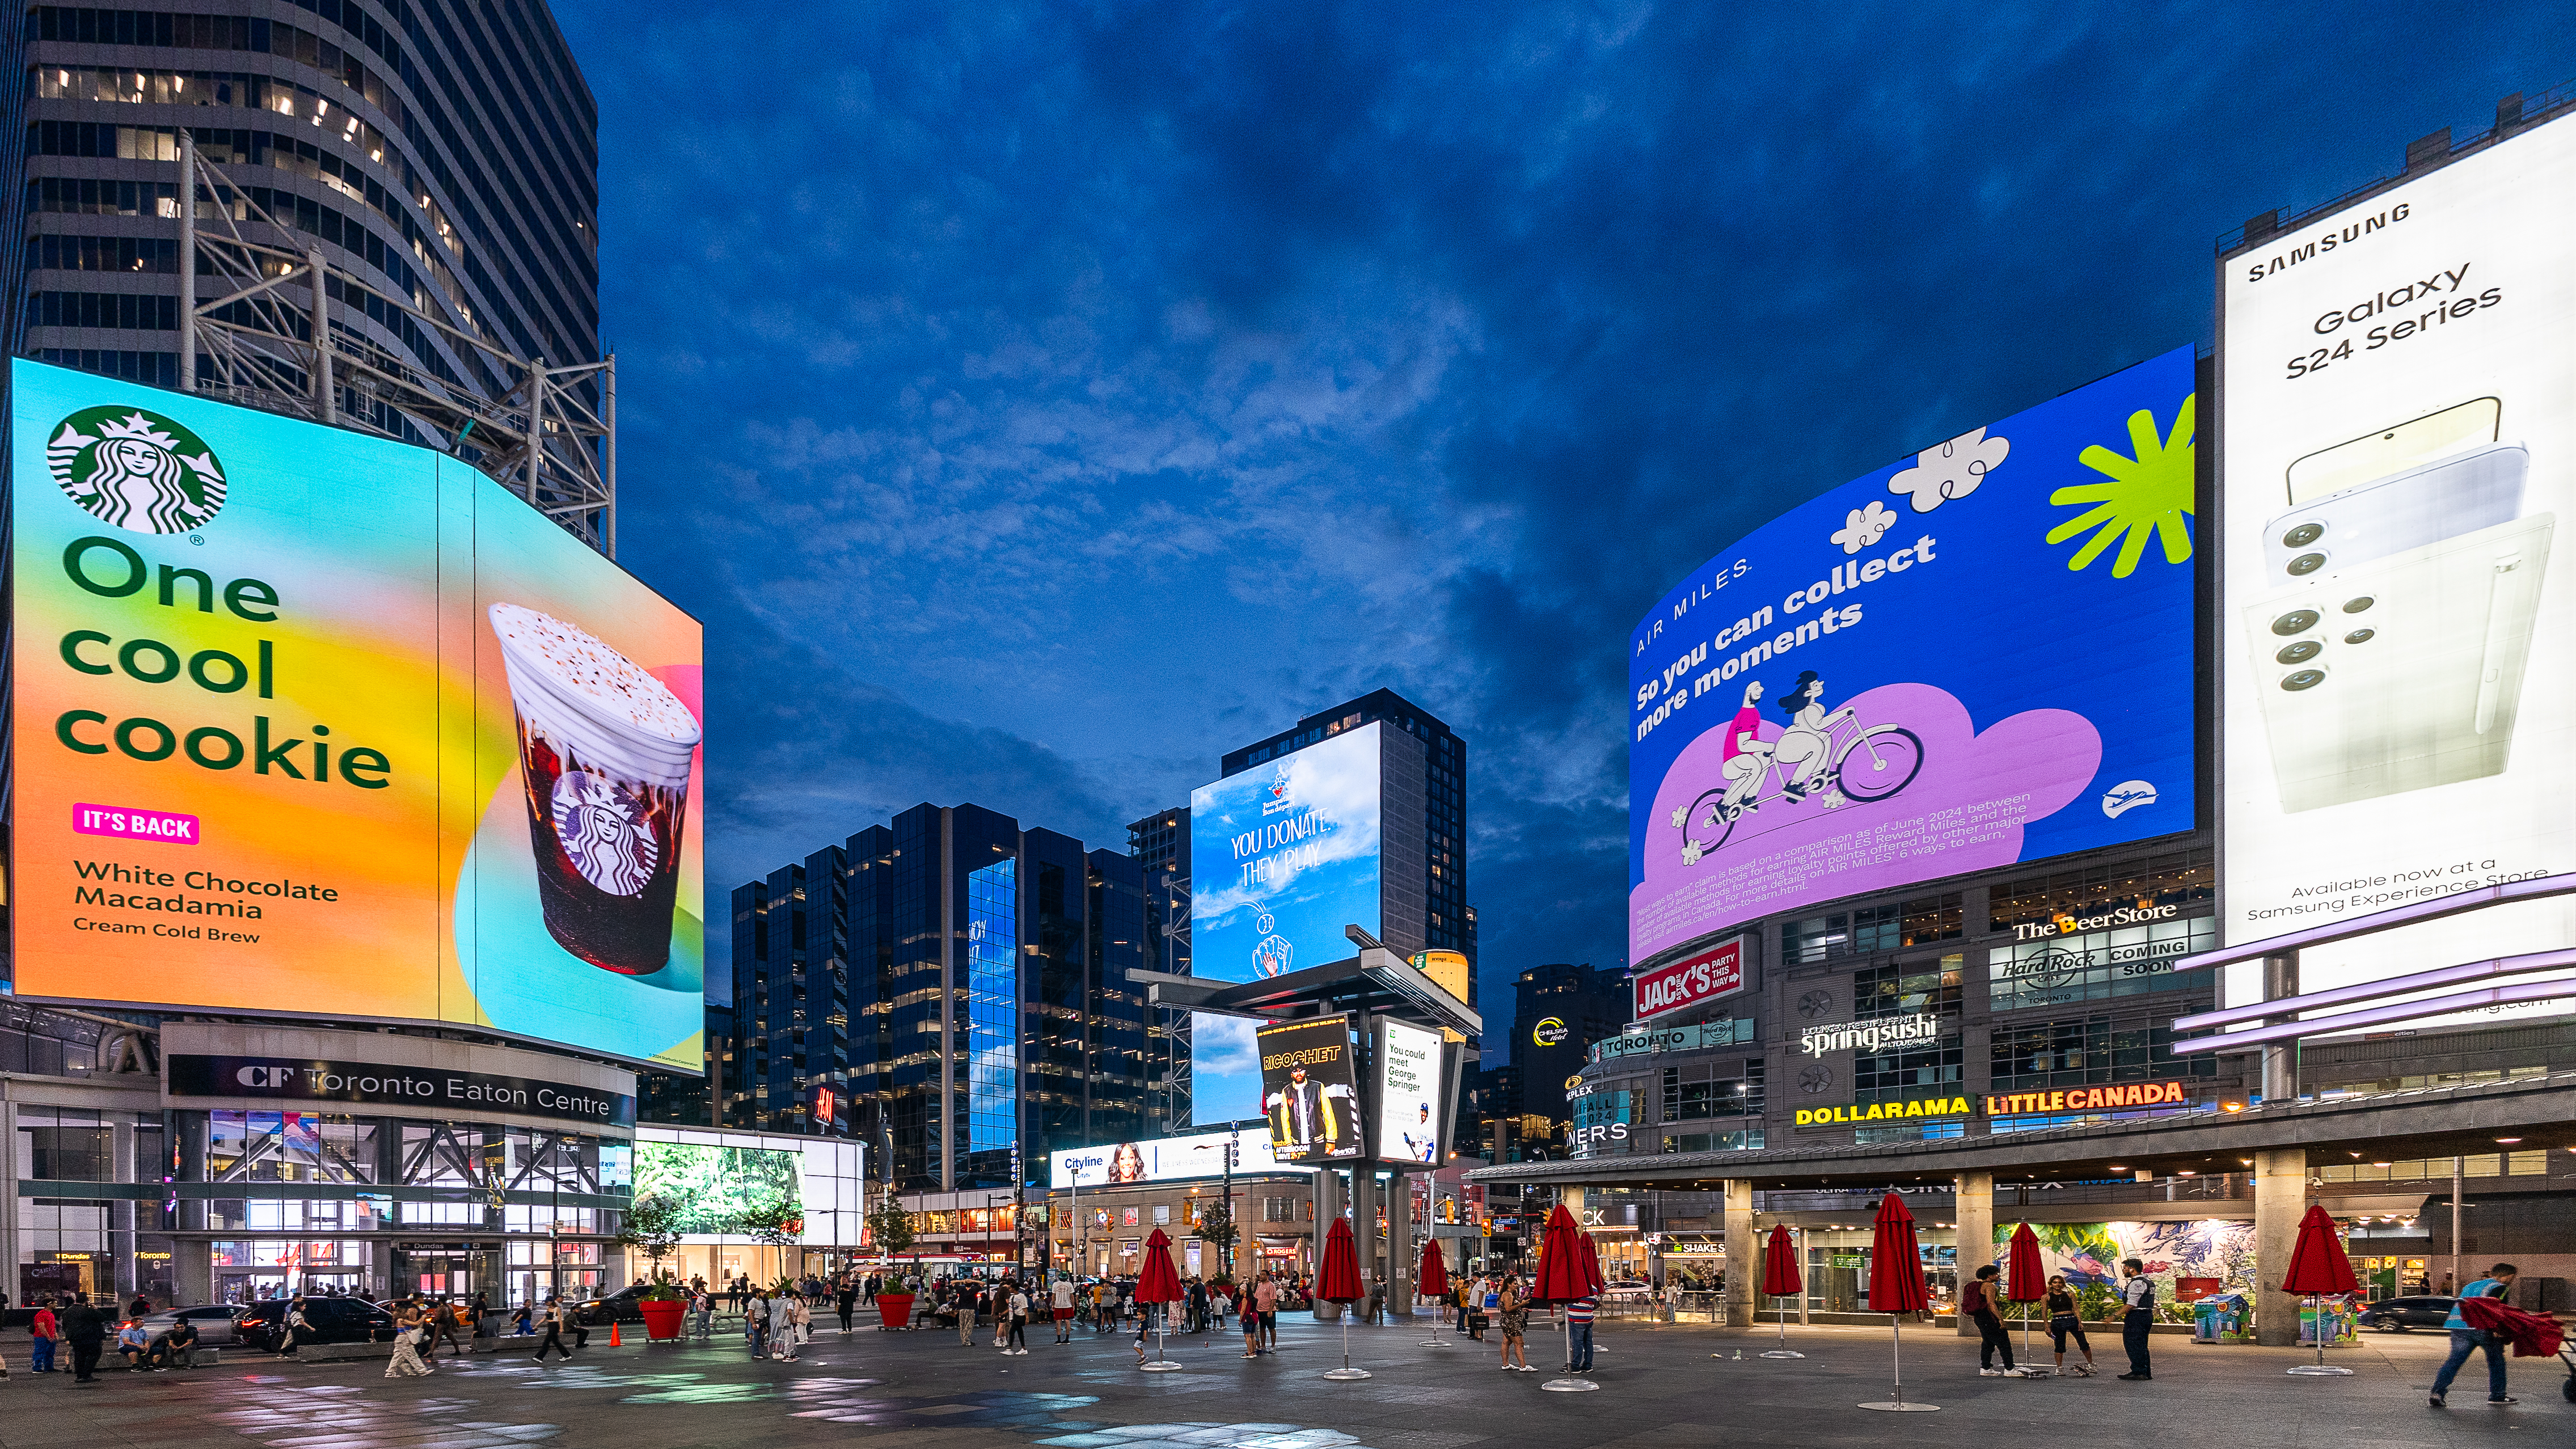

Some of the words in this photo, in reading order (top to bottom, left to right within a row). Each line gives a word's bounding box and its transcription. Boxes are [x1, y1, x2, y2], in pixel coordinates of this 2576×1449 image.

[2249, 203, 2410, 282] SAMSUNG
[2314, 261, 2471, 335] Galaxy
[2286, 338, 2354, 379] S24
[2366, 288, 2502, 350] Series
[63, 536, 279, 622] One
[1637, 677, 1659, 711] So
[1662, 642, 1707, 694] you
[1714, 604, 1773, 652] can
[1783, 534, 1936, 615] collect
[1637, 620, 1663, 657] AIR
[60, 630, 273, 699] cool
[1637, 686, 1688, 742] more
[1694, 603, 1864, 699] moments
[55, 709, 391, 789] cookie
[1262, 794, 1295, 811] Jumpstart
[1262, 807, 1275, 817] Bon
[1274, 801, 1295, 813] départ
[131, 813, 192, 839] BACK
[1231, 828, 1262, 860] YOU
[1267, 808, 1331, 849] DONATE.
[1695, 876, 1716, 889] claim
[1728, 859, 1756, 875] based
[1759, 855, 1772, 865] on
[1784, 833, 1852, 857] comparison
[1856, 829, 1870, 838] as
[1874, 822, 1889, 834] of
[1891, 817, 1924, 831] June
[1928, 807, 1962, 822] 2024
[1967, 793, 2030, 814] between
[1240, 854, 1278, 886] THEY
[1284, 840, 1322, 875] PLAY.
[1637, 919, 1656, 934] number
[1656, 914, 1663, 923] of
[1663, 902, 1692, 919] available
[1694, 889, 1730, 906] methods
[1732, 882, 1746, 892] for
[1748, 869, 1785, 886] earning
[1788, 859, 1825, 875] loyalty
[1828, 849, 1866, 865] points
[1870, 837, 1917, 855] offered
[1923, 834, 1939, 844] by
[1942, 825, 1980, 839] other
[1985, 814, 2028, 830] major
[1645, 906, 1667, 922] number
[1667, 899, 1674, 909] of
[1675, 887, 1707, 905] available
[1709, 872, 1748, 892] methods
[1750, 866, 1764, 877] for
[1767, 854, 1807, 872] earning
[1809, 847, 1829, 860] AIR
[1833, 837, 1871, 854] MILES
[1876, 826, 1925, 844] Reward
[1930, 818, 1966, 833] Miles
[1970, 809, 1997, 823] and
[2002, 804, 2027, 816] the
[73, 860, 175, 888] White
[184, 871, 339, 902] Chocolate
[1637, 928, 1653, 941] loyalty
[1653, 914, 1682, 935] programs
[1691, 900, 1723, 915] Canada.
[1725, 893, 1739, 903] For
[1742, 885, 1767, 898] more
[1771, 873, 1806, 889] details
[1809, 869, 1825, 878] on
[1827, 862, 1848, 875] AIR
[1899, 850, 1907, 859] 6
[1912, 842, 1946, 856] ways
[1949, 839, 1965, 848] to
[1969, 831, 2005, 844] earn,
[2292, 876, 2387, 899] Available
[2393, 868, 2443, 885] now
[2450, 861, 2474, 875] at
[2481, 859, 2496, 870] a
[74, 886, 263, 920] Macadamia
[2248, 899, 2345, 922] Samsung
[2351, 878, 2479, 907] Experience
[2486, 868, 2549, 886] Store
[73, 917, 146, 935] Cream
[153, 923, 200, 940] Cold
[208, 928, 260, 944] Brew
[2012, 922, 2056, 940] The
[2058, 914, 2114, 934] Beer
[2114, 905, 2177, 925] Store
[1637, 936, 1653, 952] please
[1653, 929, 1665, 941] visit
[2110, 941, 2185, 961] COMING
[1712, 953, 1735, 969] PARTY
[1712, 965, 1729, 979] THIS
[2002, 958, 2049, 977] Hard
[2049, 950, 2096, 971] Rock
[1712, 975, 1729, 988] WAY
[2037, 973, 2062, 983] CAFE
[2028, 994, 2071, 1004] TORONTO
[1539, 1028, 1568, 1037] CHELSEA
[1549, 1033, 1568, 1041] Hotel
[1607, 1032, 1685, 1053] TORONTO
[1263, 1045, 1341, 1071] RICOCHET
[1389, 1057, 1408, 1067] meet
[1390, 1044, 1403, 1055] You
[1405, 1050, 1425, 1060] could
[1388, 1066, 1416, 1081] George
[1388, 1077, 1421, 1092] Springer
[237, 1066, 294, 1088] CF
[303, 1068, 434, 1096] Toronto
[447, 1079, 527, 1105] Eaton
[537, 1088, 610, 1116] Centre
[1987, 1091, 2064, 1116] LITTLE
[2066, 1081, 2185, 1109] CANADA
[1582, 1111, 1612, 1126] 2024
[1796, 1097, 1971, 1126] DOLLARAMA
[1230, 1120, 1240, 1167] Yonge
[1276, 1144, 1310, 1154] AFTERNOON
[1065, 1156, 1103, 1170] Cityline
[1683, 1243, 1717, 1253] SHAKE
